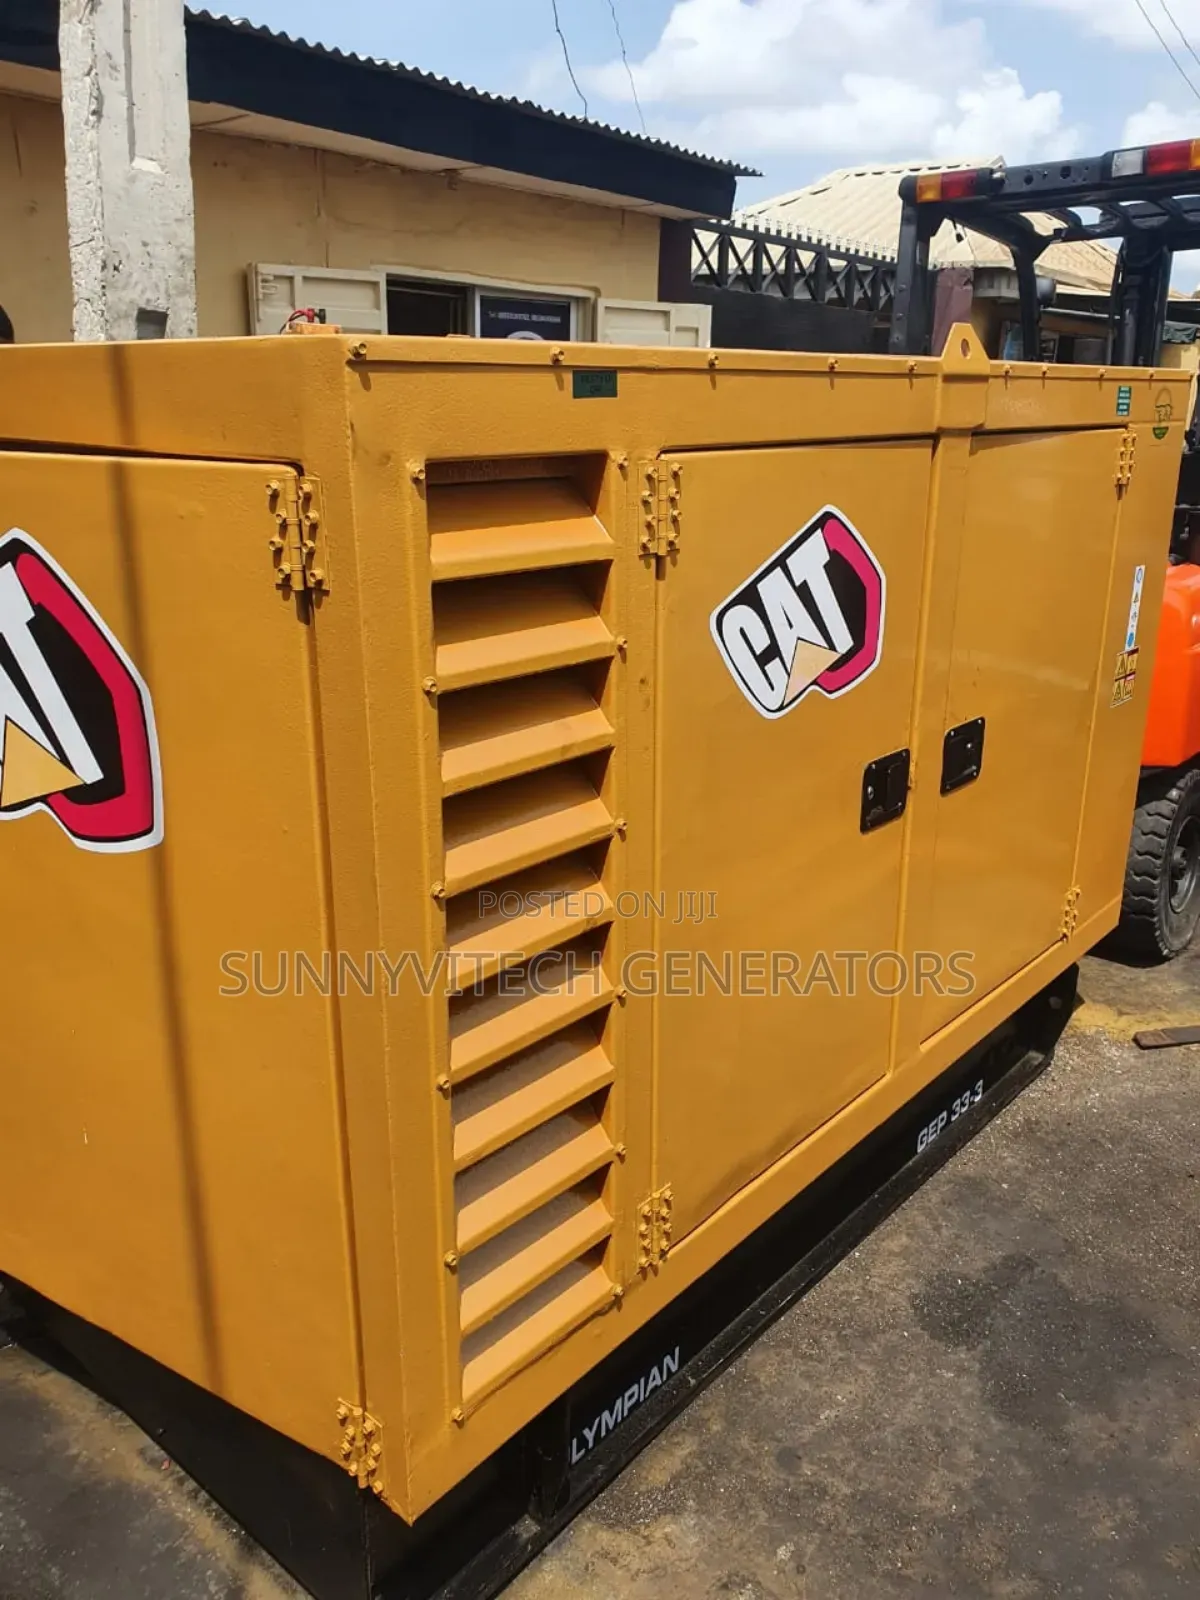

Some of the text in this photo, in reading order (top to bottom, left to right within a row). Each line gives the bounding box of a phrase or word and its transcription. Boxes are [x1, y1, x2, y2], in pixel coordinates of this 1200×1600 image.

[721, 527, 855, 711] CAT
[917, 1079, 984, 1153] GEP 33-3
[571, 1345, 680, 1465] LYMPIAN
